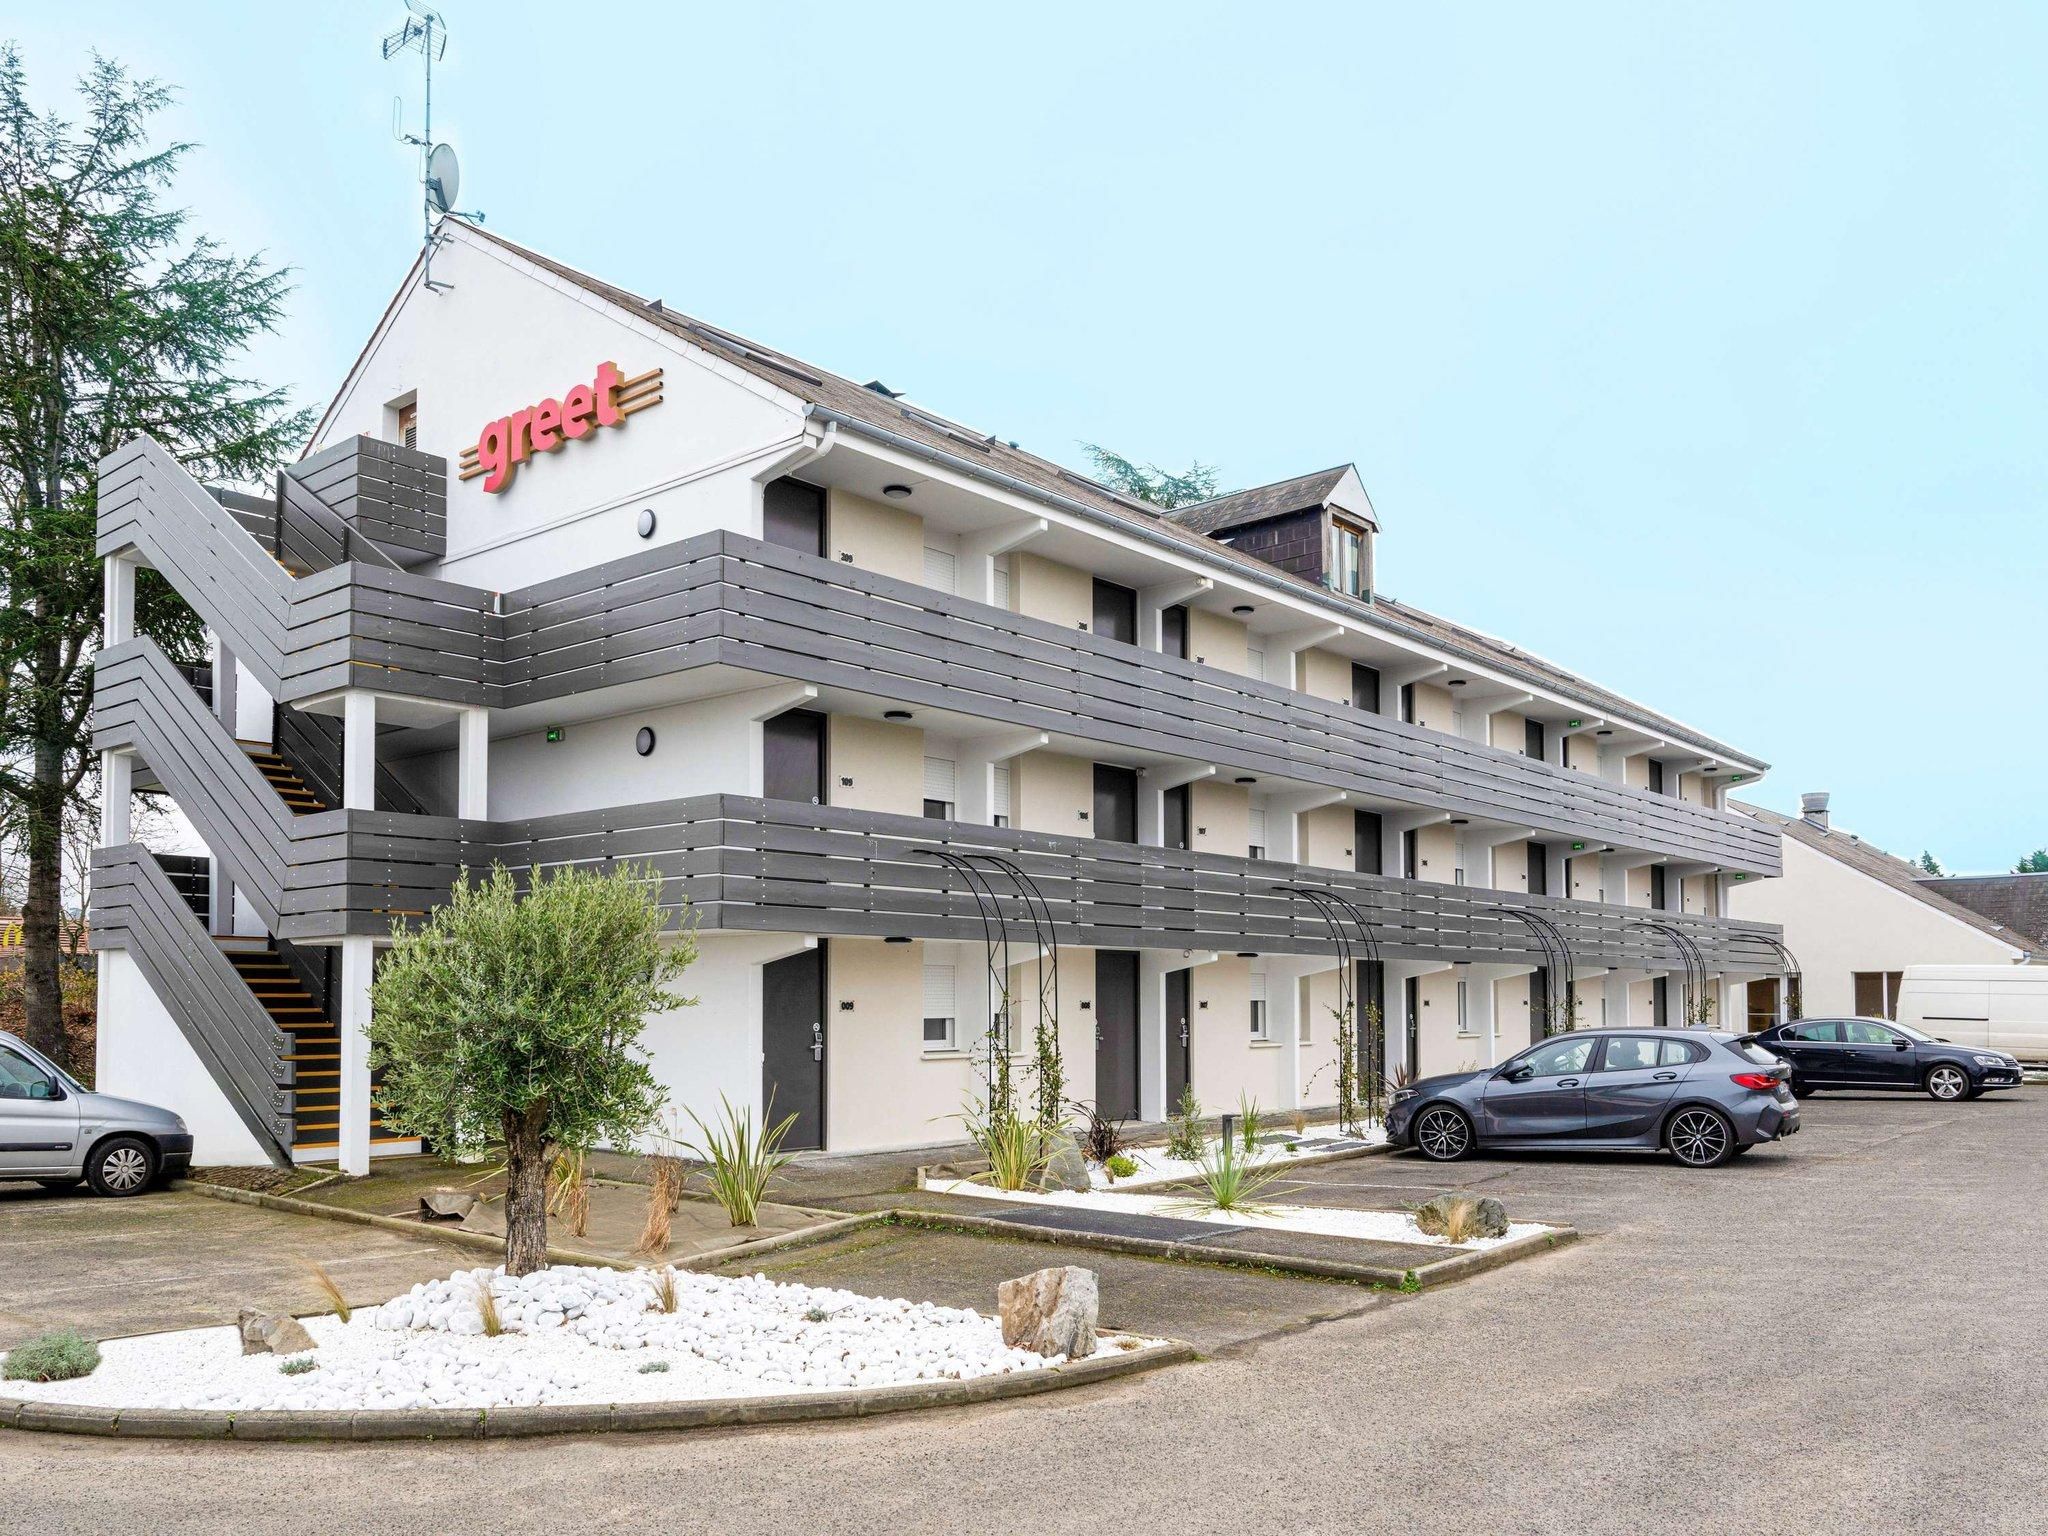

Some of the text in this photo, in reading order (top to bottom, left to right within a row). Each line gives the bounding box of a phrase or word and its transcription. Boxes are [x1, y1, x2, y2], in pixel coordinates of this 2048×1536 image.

[478, 360, 625, 494] greet
[841, 552, 853, 563] 209
[841, 777, 853, 786] 109
[841, 1001, 854, 1010] 009
